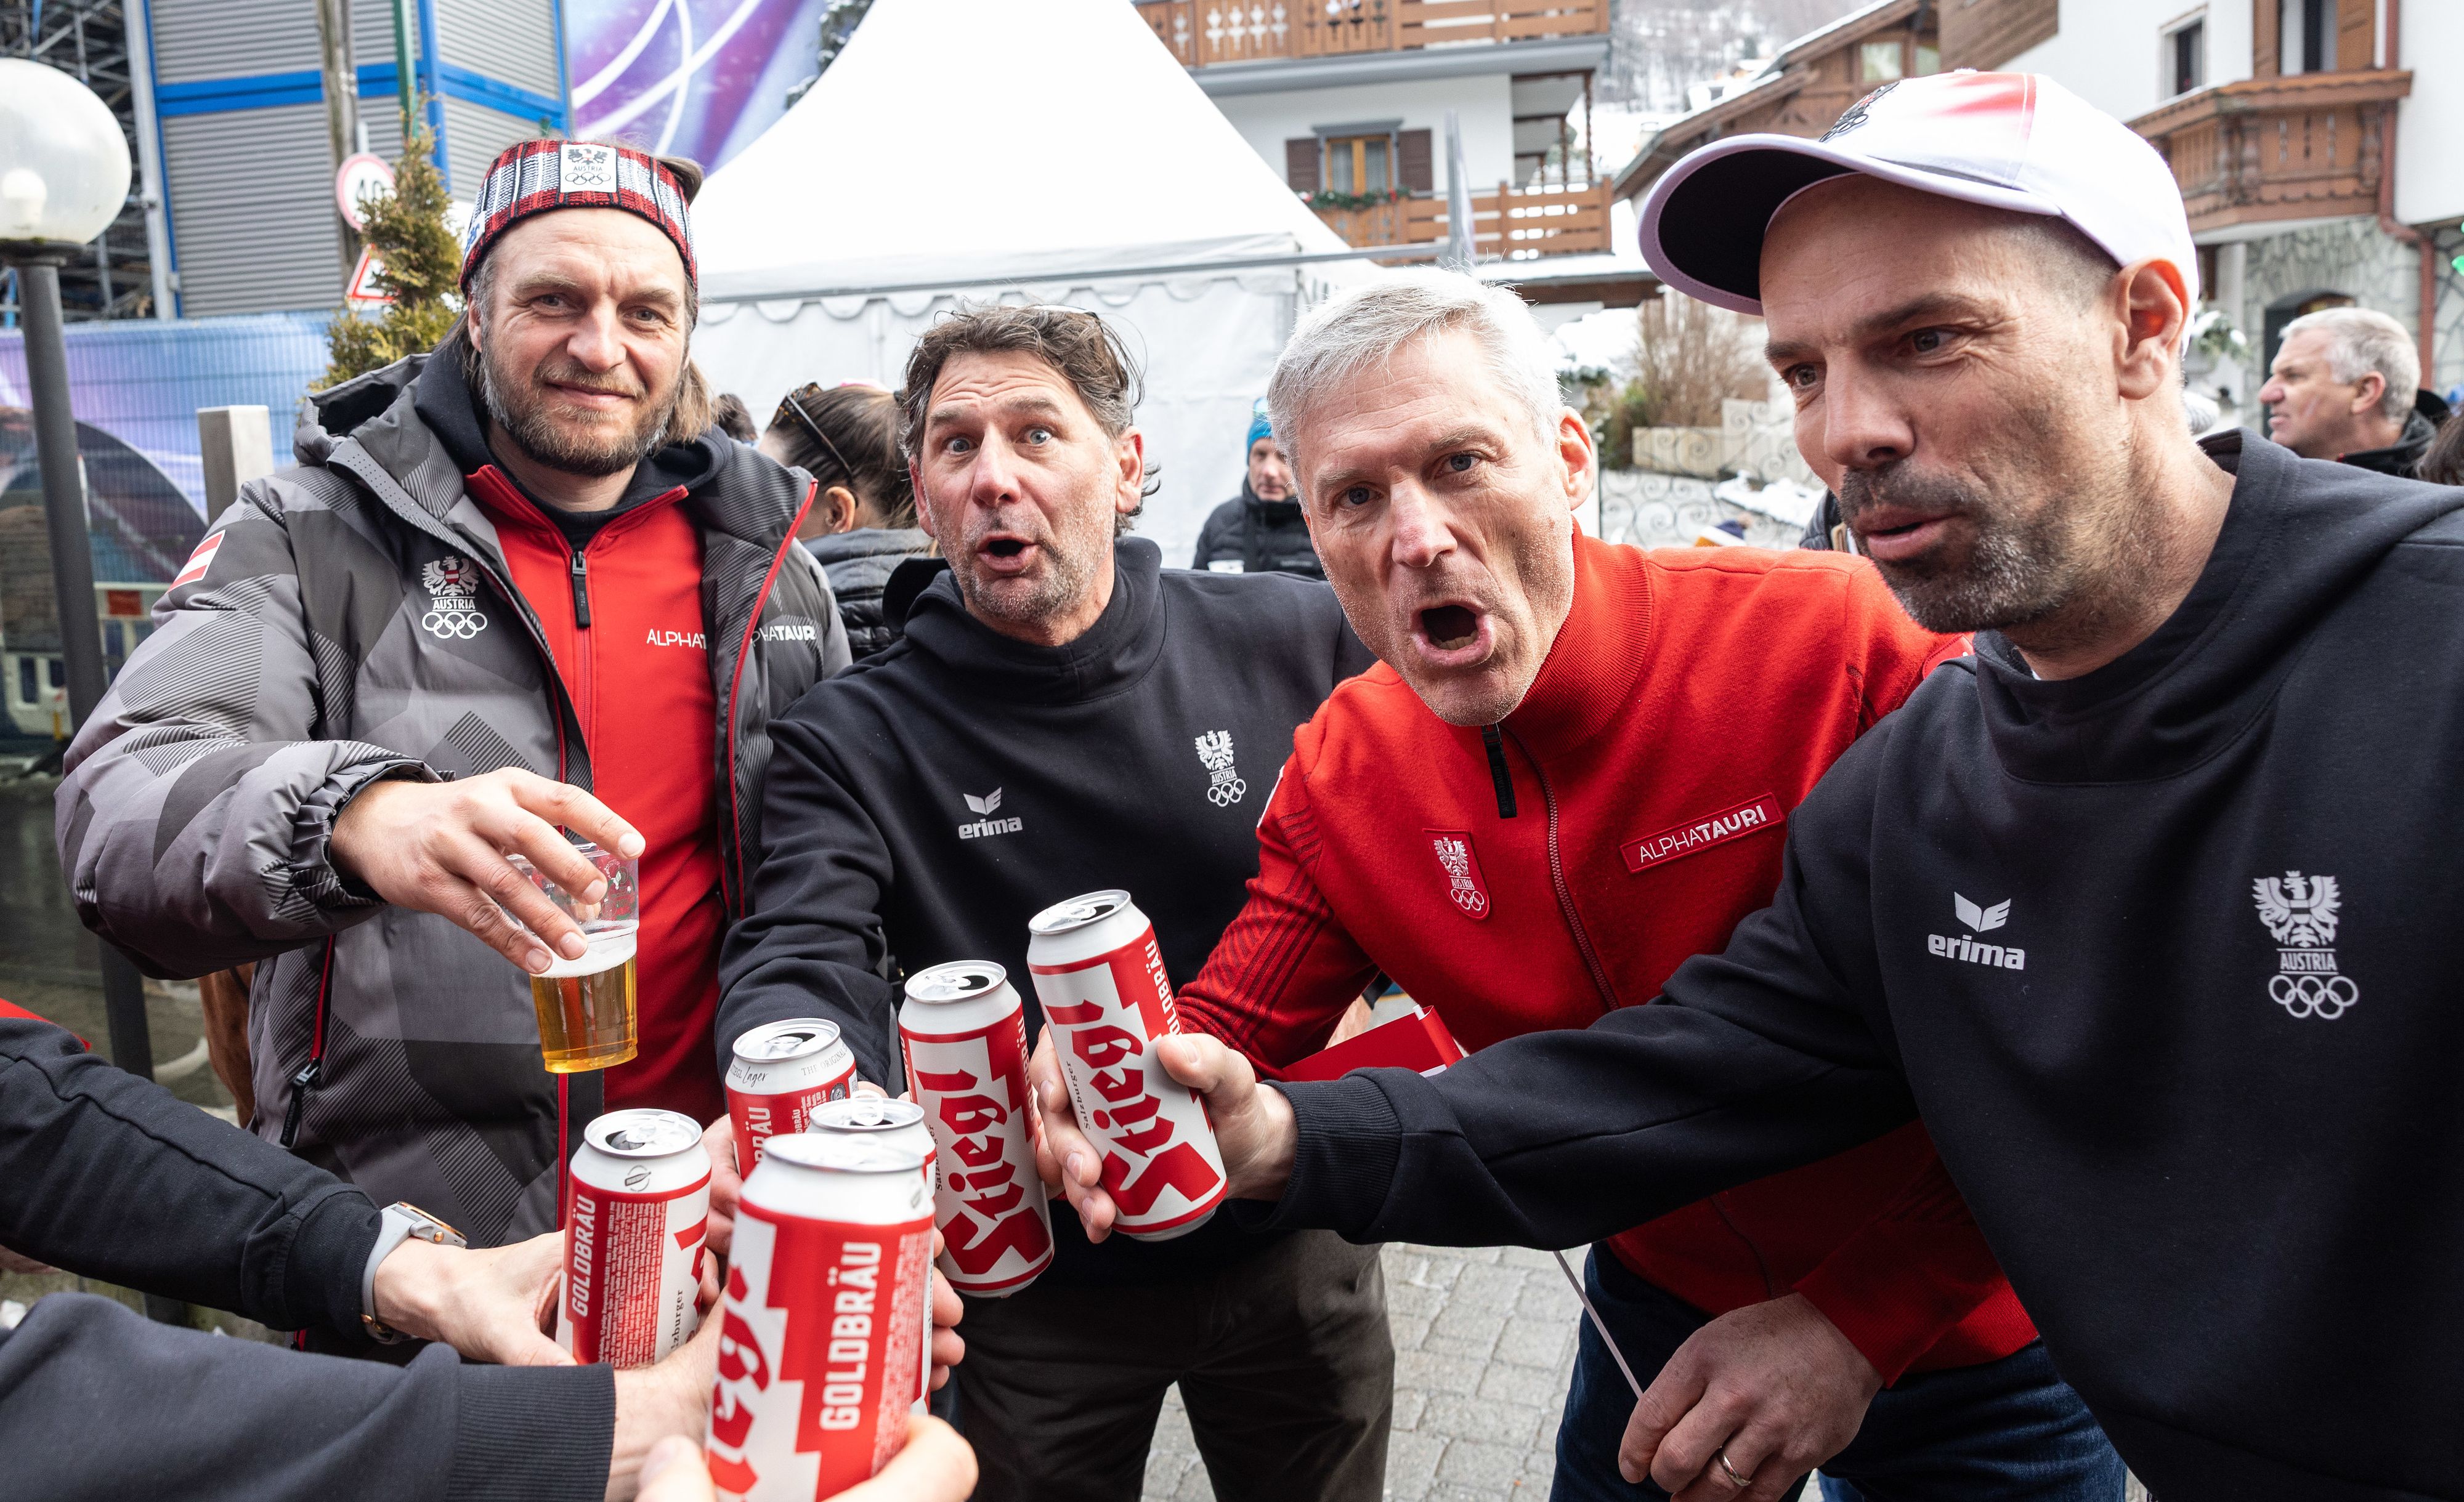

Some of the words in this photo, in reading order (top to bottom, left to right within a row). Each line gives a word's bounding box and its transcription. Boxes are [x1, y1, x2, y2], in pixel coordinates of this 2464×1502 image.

[432, 599, 476, 609] AUSTRIA
[646, 628, 707, 650] ALPHAT
[1211, 769, 1237, 785] AUSTRIA
[958, 816, 1023, 840] erima
[1640, 804, 1767, 863] ALPHATAURI
[1451, 877, 1475, 890] AUSTRIA
[1927, 933, 2025, 971] erima
[2280, 952, 2337, 972] AUSTRIA
[1145, 939, 1183, 1036] OLDBRÄU
[742, 1065, 769, 1088] Lager
[820, 1047, 846, 1069] ORIGINAL
[1046, 999, 1220, 1217] Stiegl
[1066, 1060, 1090, 1131] Salzburger
[744, 1106, 773, 1163] BRÄU
[791, 1109, 803, 1134] DBRÄU
[915, 1068, 1052, 1275] Stiegl
[572, 1194, 596, 1317] GOLDBRÄU
[671, 1289, 684, 1350] lzburger
[819, 1241, 882, 1431] GOLDBRÄU
